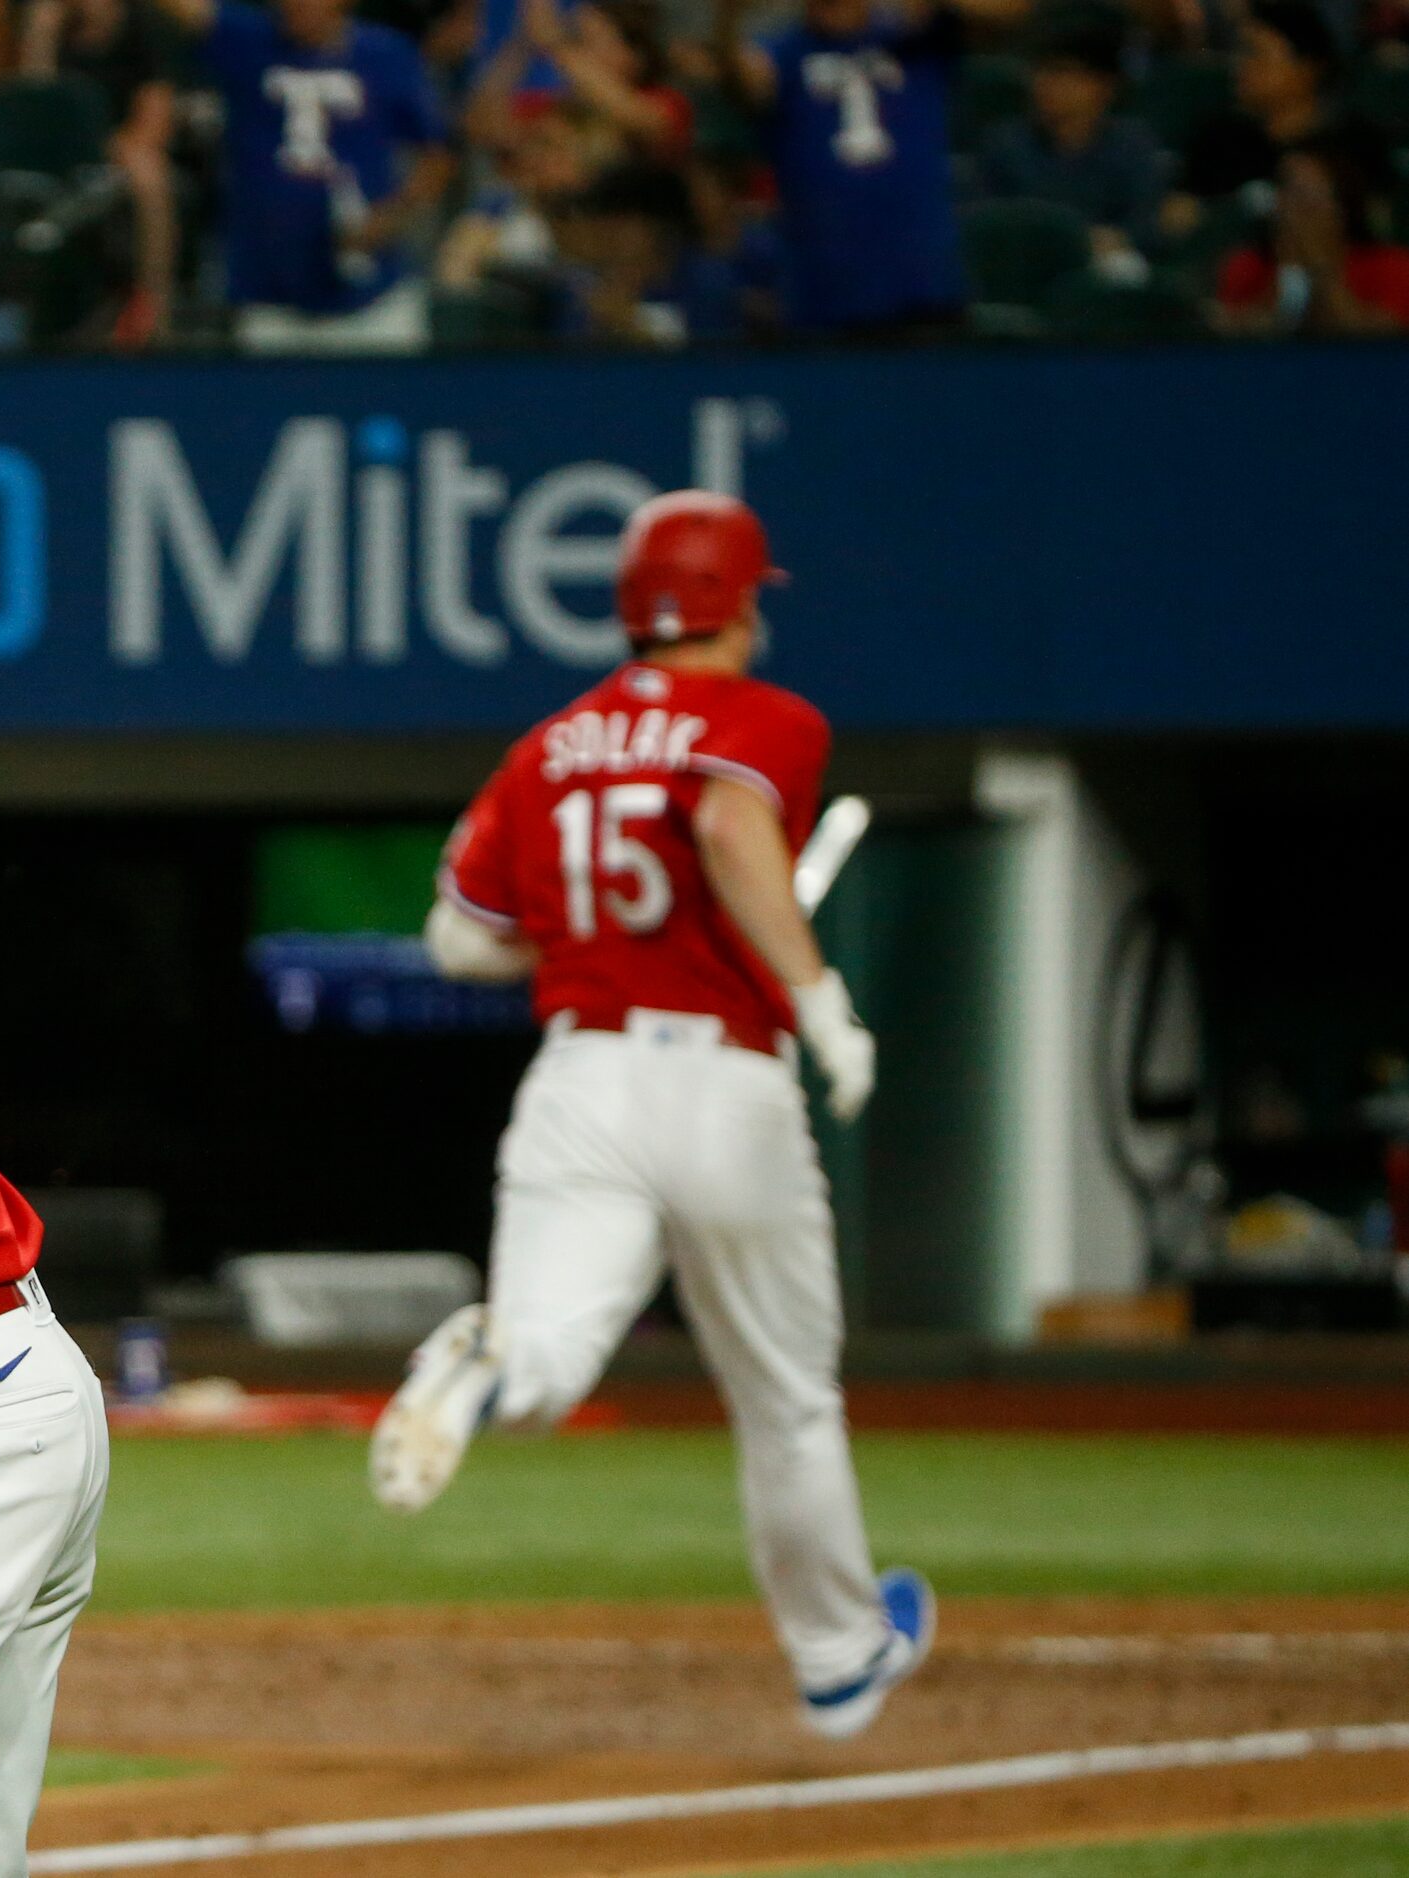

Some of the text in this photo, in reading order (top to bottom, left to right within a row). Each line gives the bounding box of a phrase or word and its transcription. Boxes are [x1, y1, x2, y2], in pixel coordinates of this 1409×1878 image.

[264, 67, 364, 178] T
[804, 50, 904, 166] T
[541, 709, 709, 783] SOLAK
[552, 785, 672, 938] 15
